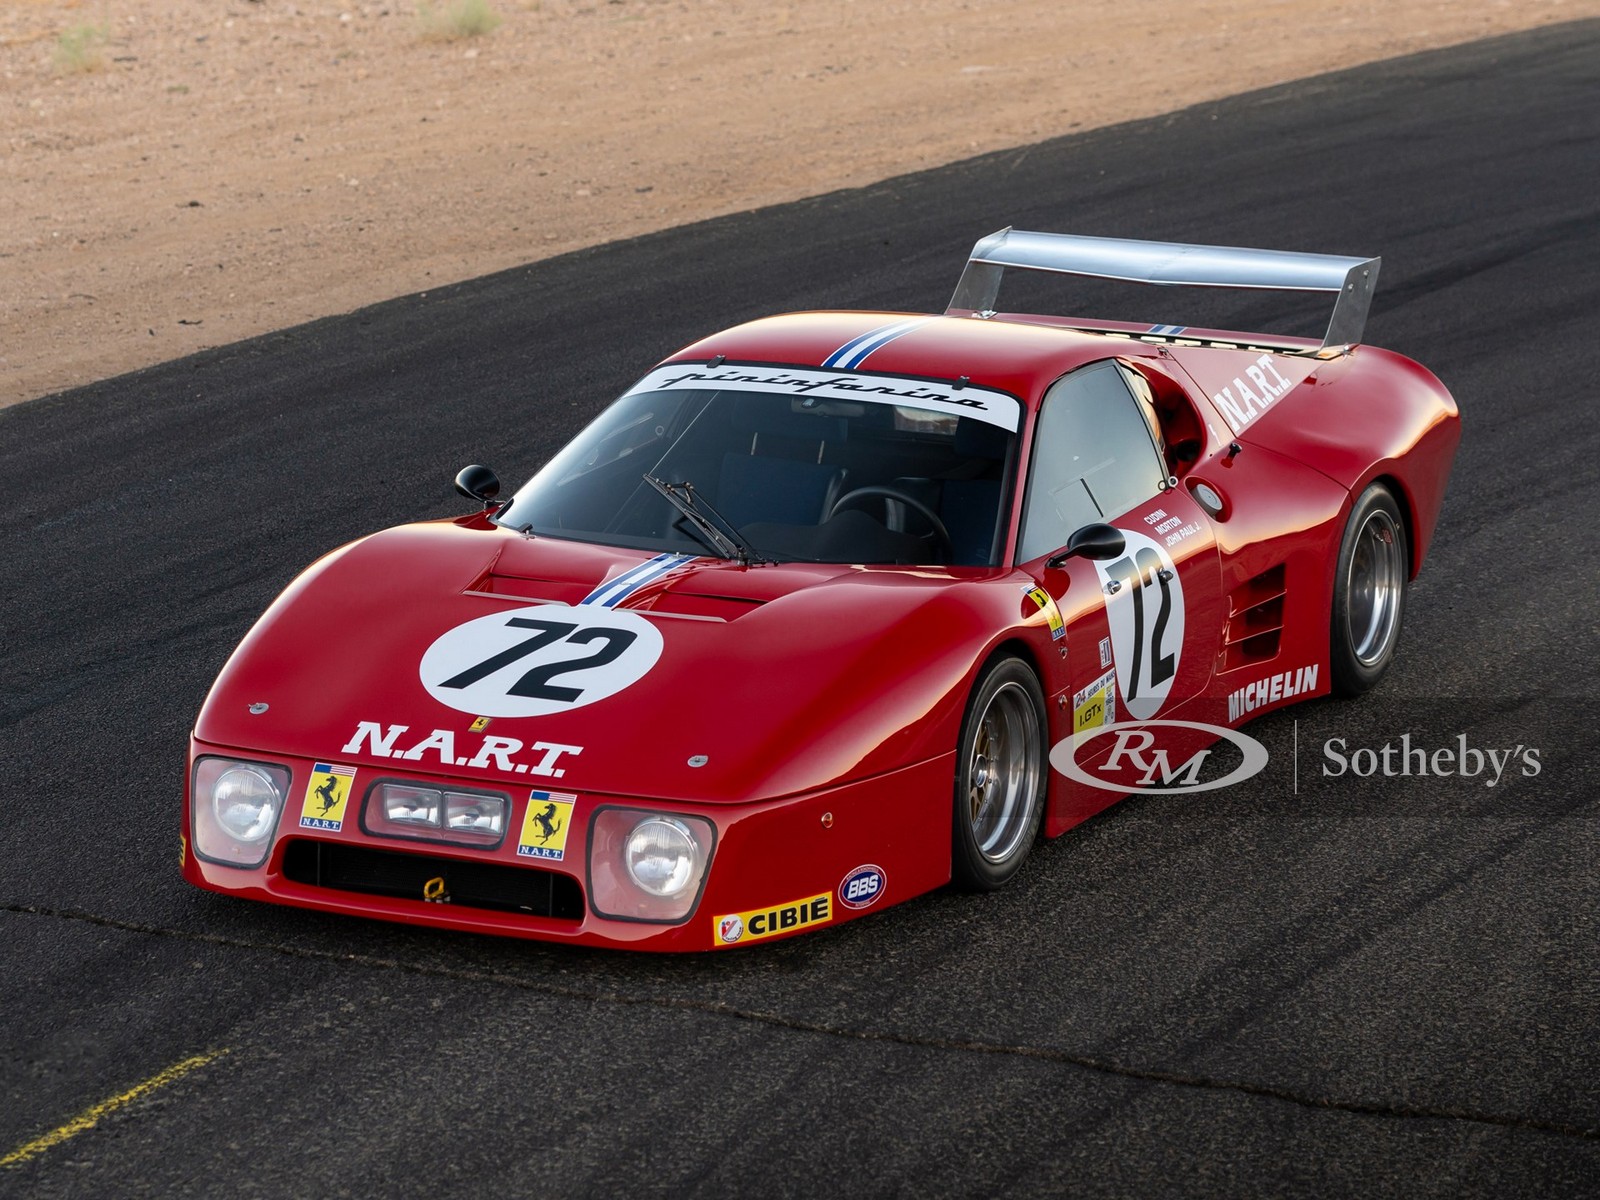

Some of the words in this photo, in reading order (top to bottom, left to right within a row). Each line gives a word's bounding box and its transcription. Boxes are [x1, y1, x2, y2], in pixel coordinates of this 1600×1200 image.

[657, 370, 989, 411] pininfarina
[1154, 515, 1182, 535] MORTON
[1104, 546, 1175, 703] 72
[437, 617, 638, 703] 72
[1228, 664, 1319, 723] MICHELIN
[341, 721, 584, 778] N.A.R.T.
[302, 816, 340, 831] N.A.R.T.
[520, 845, 561, 860] N.A.R.T.
[847, 874, 879, 899] BBS
